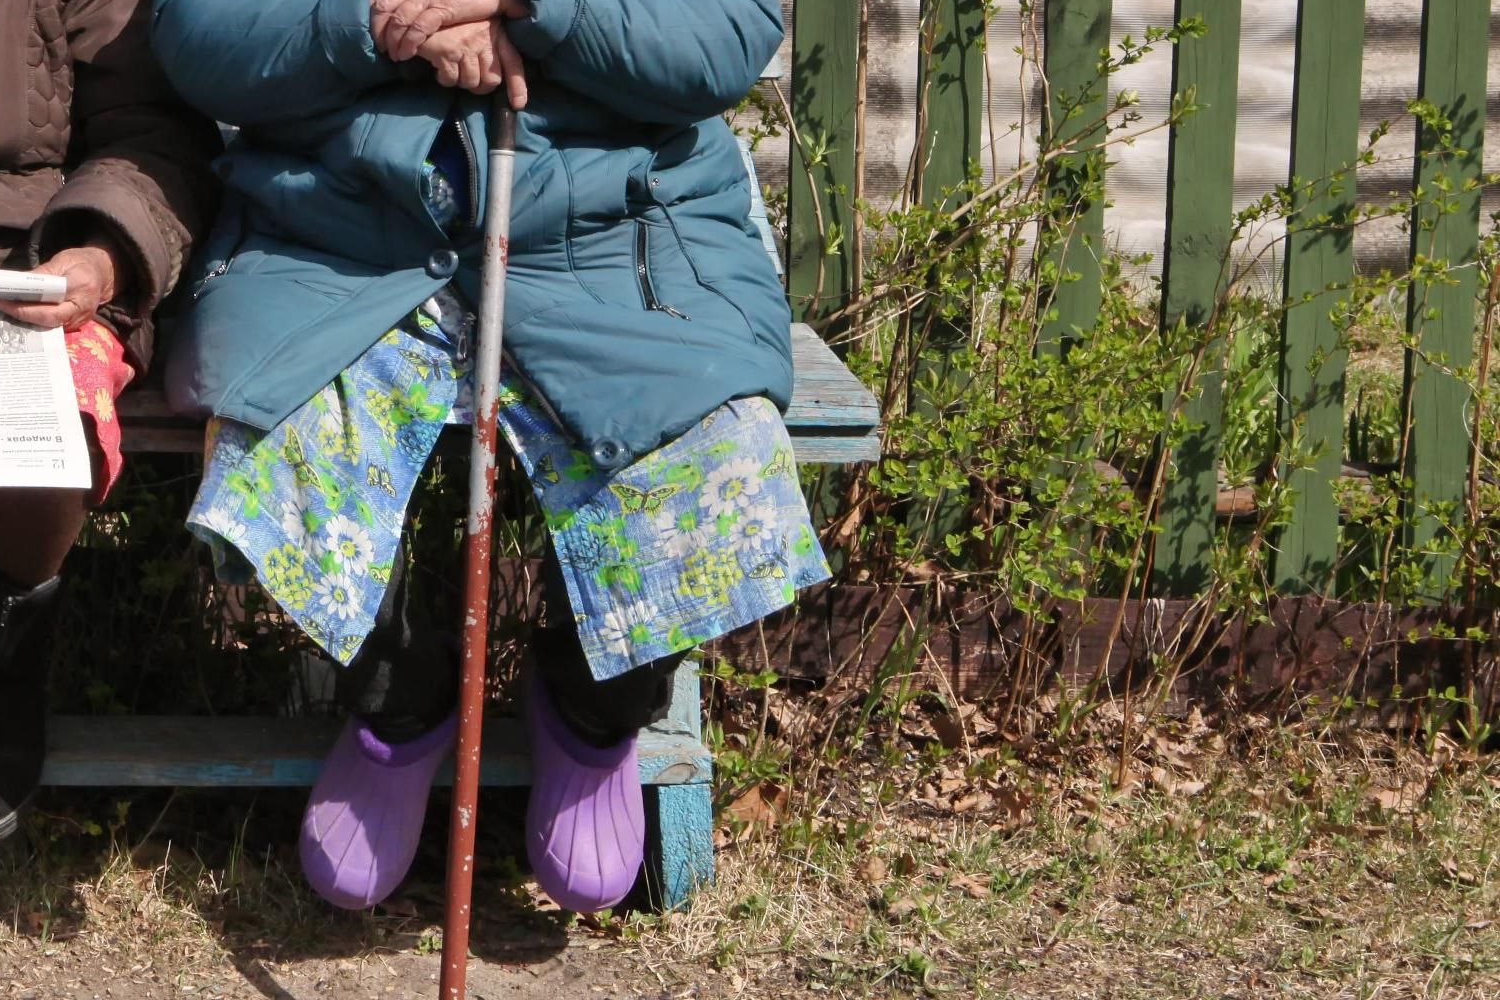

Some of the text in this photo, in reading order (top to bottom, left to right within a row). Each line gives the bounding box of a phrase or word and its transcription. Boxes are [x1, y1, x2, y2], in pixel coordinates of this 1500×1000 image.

[6, 435, 52, 443] лидерах
[55, 435, 63, 443] В
[51, 458, 66, 470] 12
